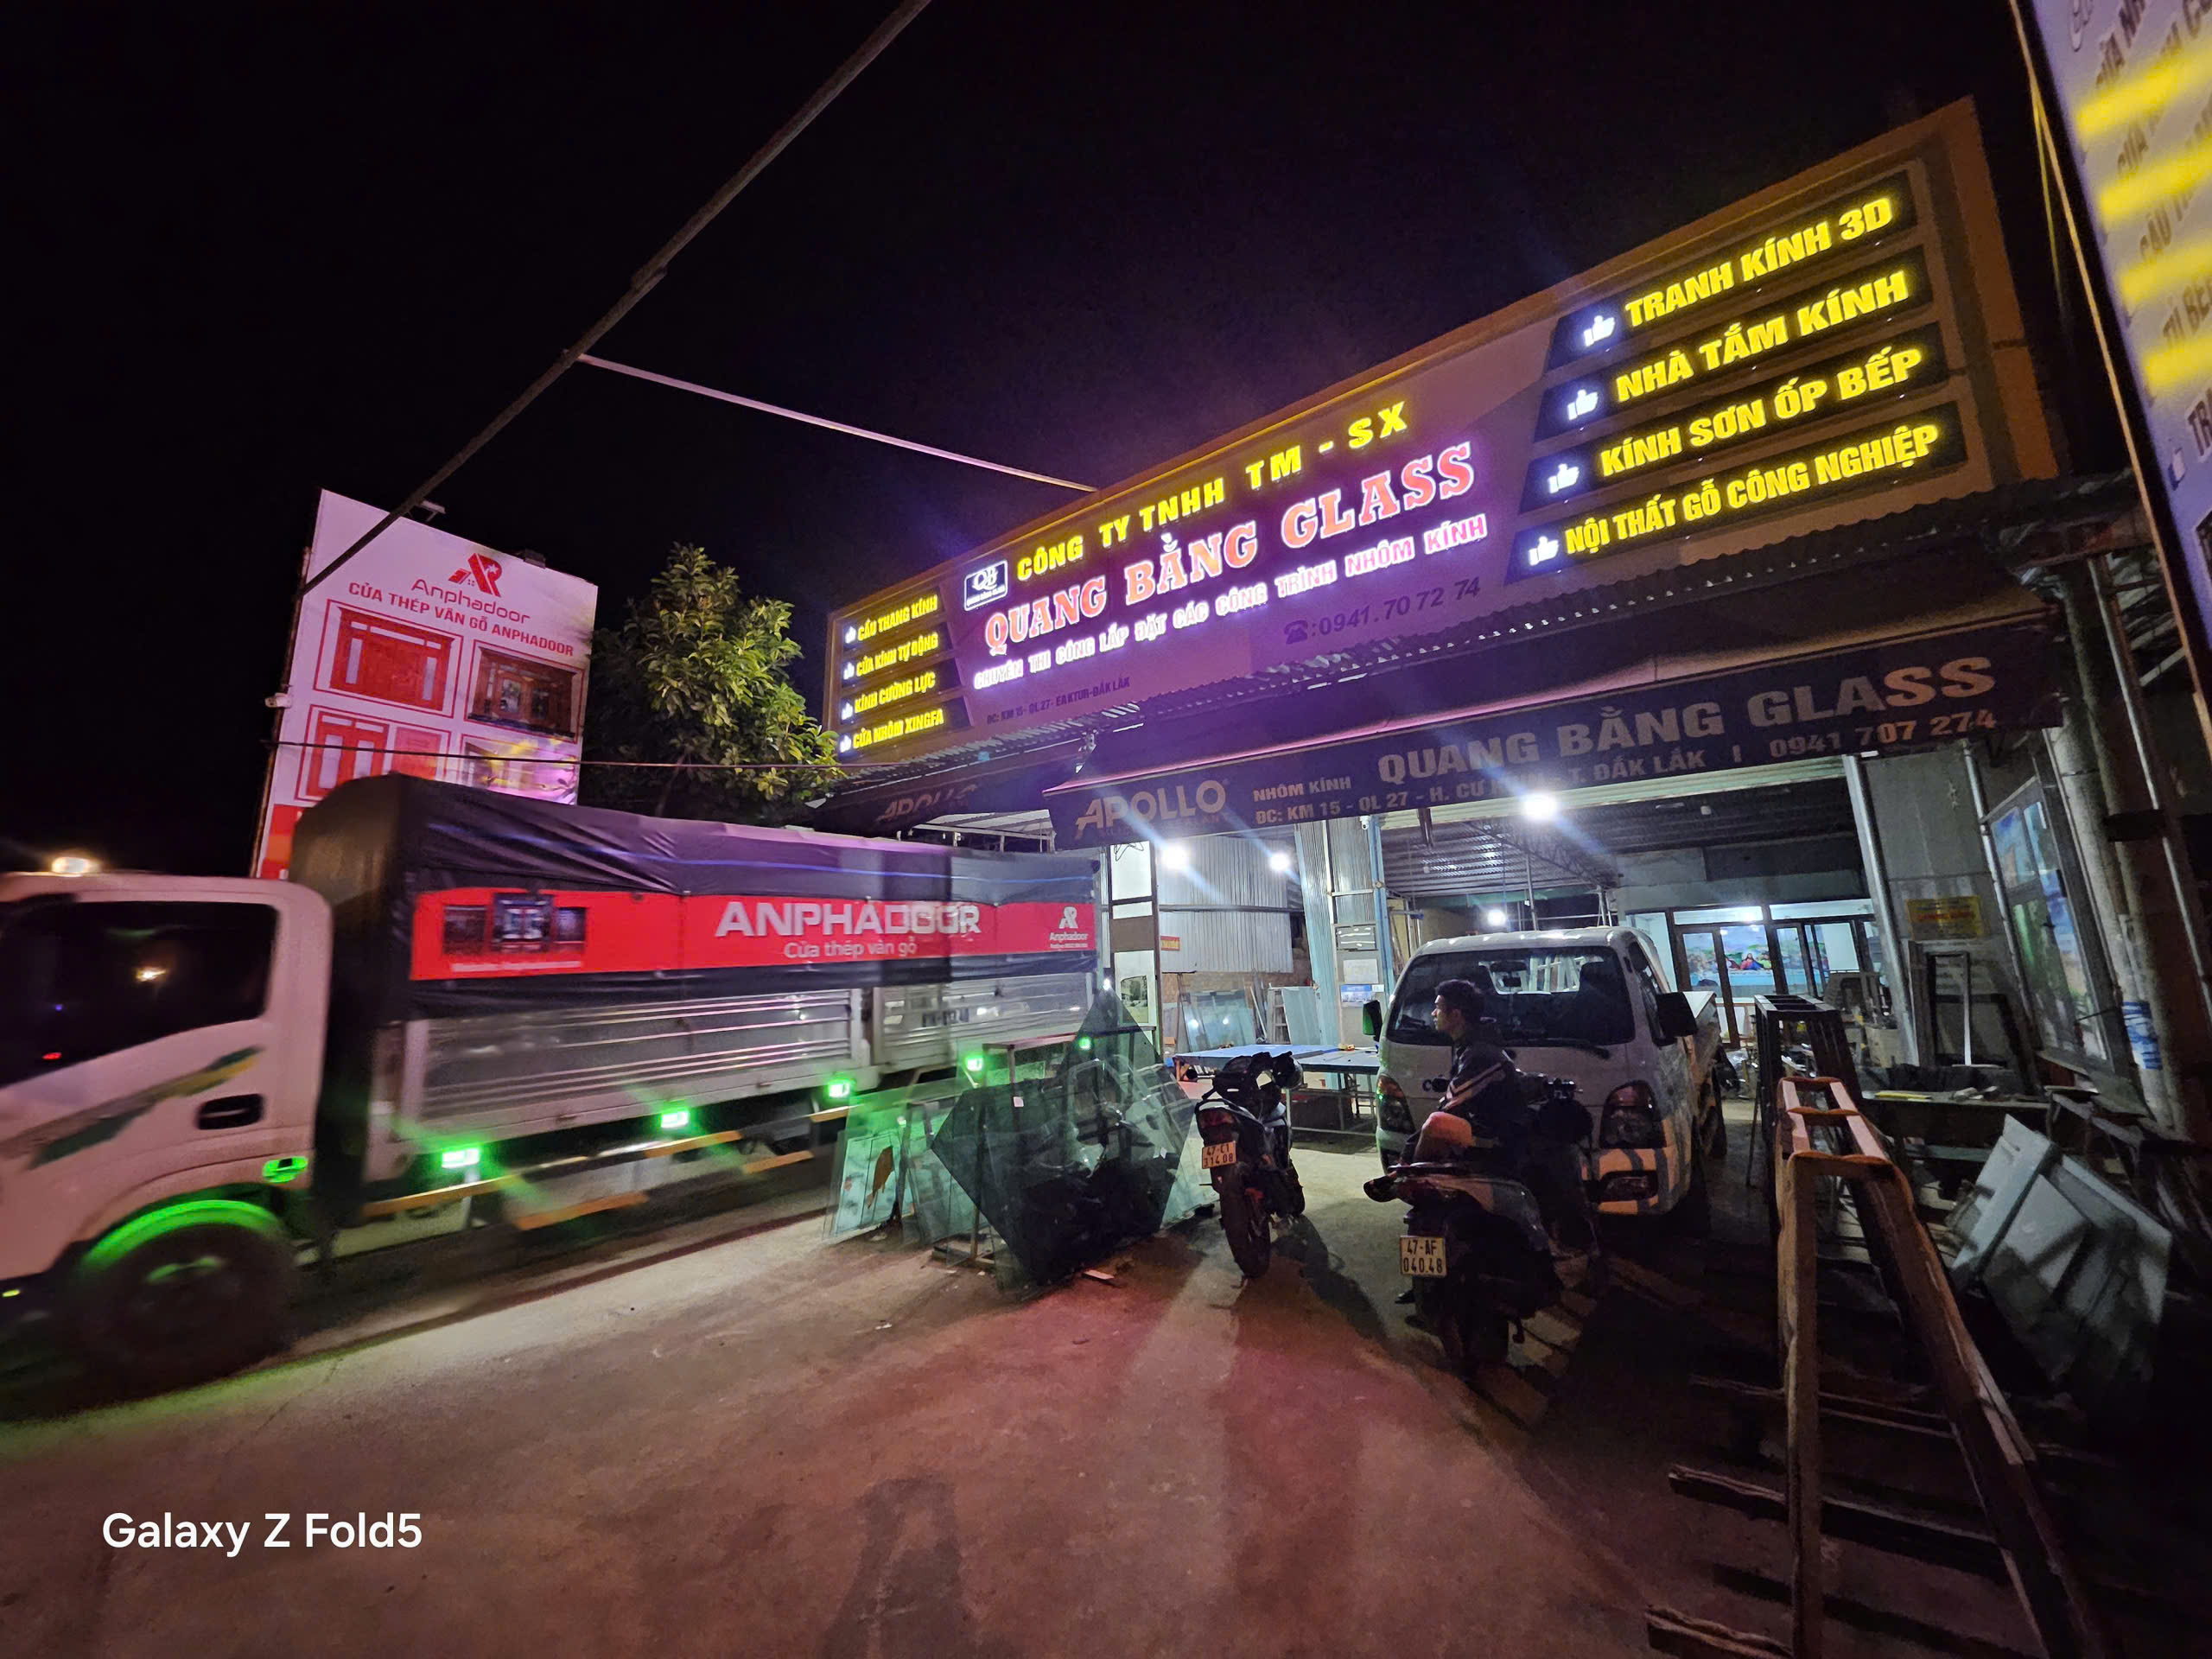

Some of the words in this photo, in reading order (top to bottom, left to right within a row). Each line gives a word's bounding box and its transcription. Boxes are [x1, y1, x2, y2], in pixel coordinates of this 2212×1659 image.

[1625, 262, 1732, 327] TRANH
[1740, 223, 1831, 283] KÍNH
[1839, 197, 1894, 241] 3D
[1616, 351, 1694, 403] NHÀ
[1699, 323, 1789, 371] TẮM
[1797, 270, 1910, 336] KÍNH
[1600, 429, 1682, 477] KÍNH
[1690, 398, 1766, 444] SƠN
[1775, 377, 1827, 421] ỐP
[1837, 346, 1923, 401] BẾP
[1017, 535, 1084, 582] CÔNG
[1099, 514, 1130, 548] TY
[1139, 477, 1225, 532] TNHH
[1245, 445, 1301, 490] TM
[1348, 401, 1408, 449] SX
[1565, 517, 1610, 554] NỘI
[1612, 493, 1676, 540] THẤT
[1682, 478, 1722, 520] GỖ
[1726, 461, 1810, 508] CÔNG
[1814, 424, 1939, 485] NGHIỆP
[985, 575, 1107, 656] QUANG
[1124, 519, 1257, 605] BẰNG
[1281, 442, 1474, 549] GLASS
[349, 582, 383, 602] CỬA
[389, 593, 430, 613] THÉP
[435, 607, 465, 626] VÂN
[469, 615, 488, 632] GỖ
[492, 624, 574, 657] ANPHADOOR
[411, 579, 531, 624] Anphadoor
[878, 607, 910, 632] THANG
[911, 594, 938, 620] KÍNH
[1028, 650, 1052, 673] THI
[1055, 637, 1096, 665] CÔNG
[1099, 622, 1129, 652] LẮP
[1173, 601, 1210, 629] CÁC
[1215, 582, 1268, 616] CÔNG
[1274, 560, 1338, 598] TRÌNH
[1344, 537, 1415, 577] NHÔM
[1423, 513, 1488, 555] KÍNH
[1454, 577, 1481, 601] 74
[874, 649, 897, 671] KÍNH
[855, 691, 878, 714] KÍNH
[874, 720, 904, 743] NHÔM
[905, 709, 944, 734] XINGFA
[1378, 732, 1540, 785] QUANG
[1746, 657, 1996, 728] GLASS
[1253, 783, 1304, 802] NHÔM
[1308, 776, 1351, 794] KÍNH
[1287, 804, 1314, 821] KM
[1320, 800, 1341, 817] 15
[1358, 795, 1382, 812] QL
[1386, 791, 1408, 808] 27
[1769, 732, 1841, 758] 0941
[1855, 721, 1916, 746] 707
[1929, 709, 1997, 734] 274
[1075, 779, 1227, 841] APOLLO
[715, 900, 982, 938] ANPHADOOR
[824, 939, 864, 959] thép
